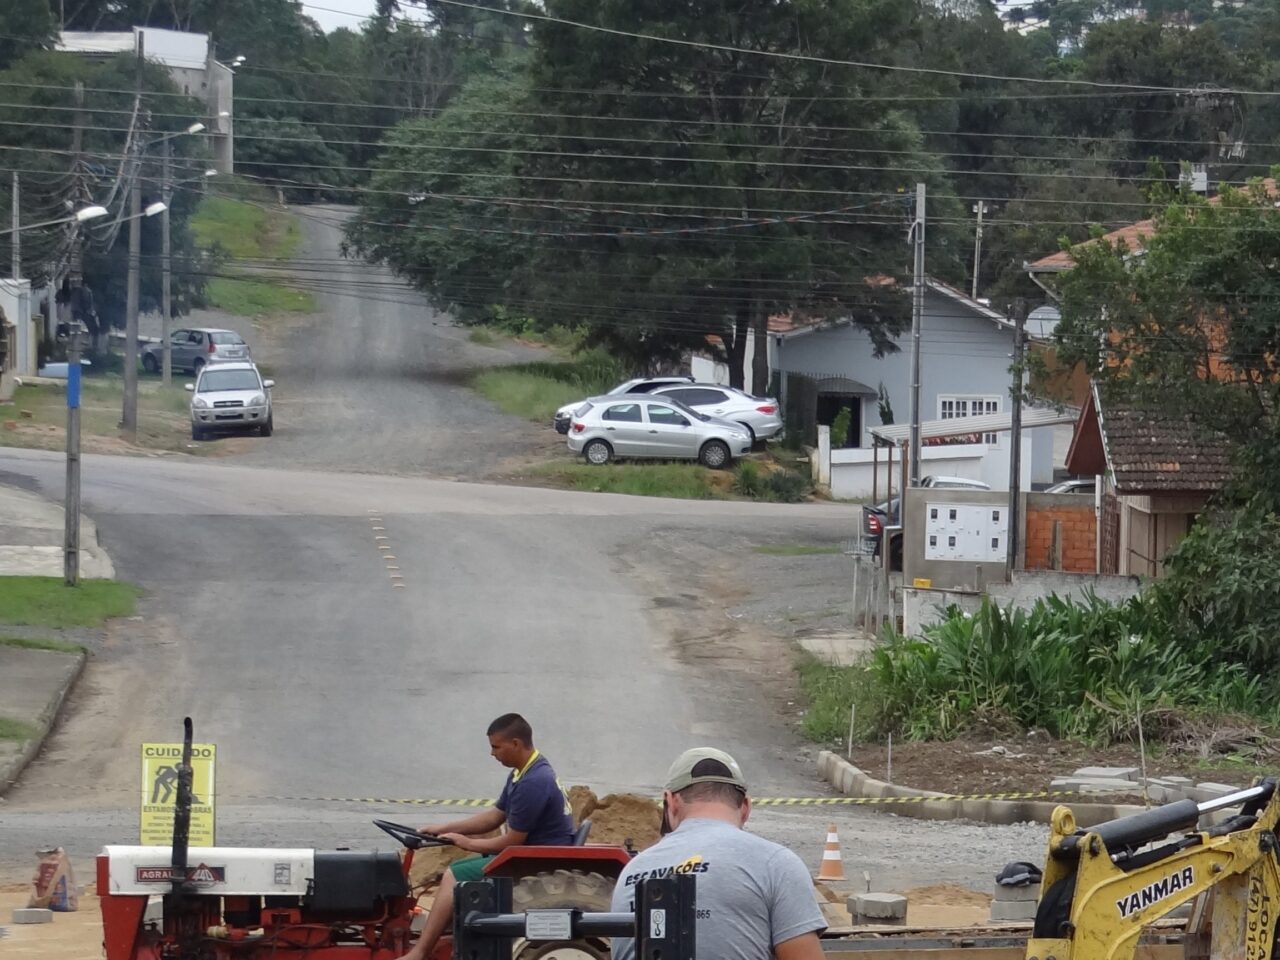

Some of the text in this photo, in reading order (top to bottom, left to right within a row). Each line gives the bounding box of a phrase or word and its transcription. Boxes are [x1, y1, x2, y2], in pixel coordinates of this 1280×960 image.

[145, 747, 211, 758] CUIDDO
[1116, 865, 1194, 918] YANMAR
[1248, 876, 1263, 914] (47)
